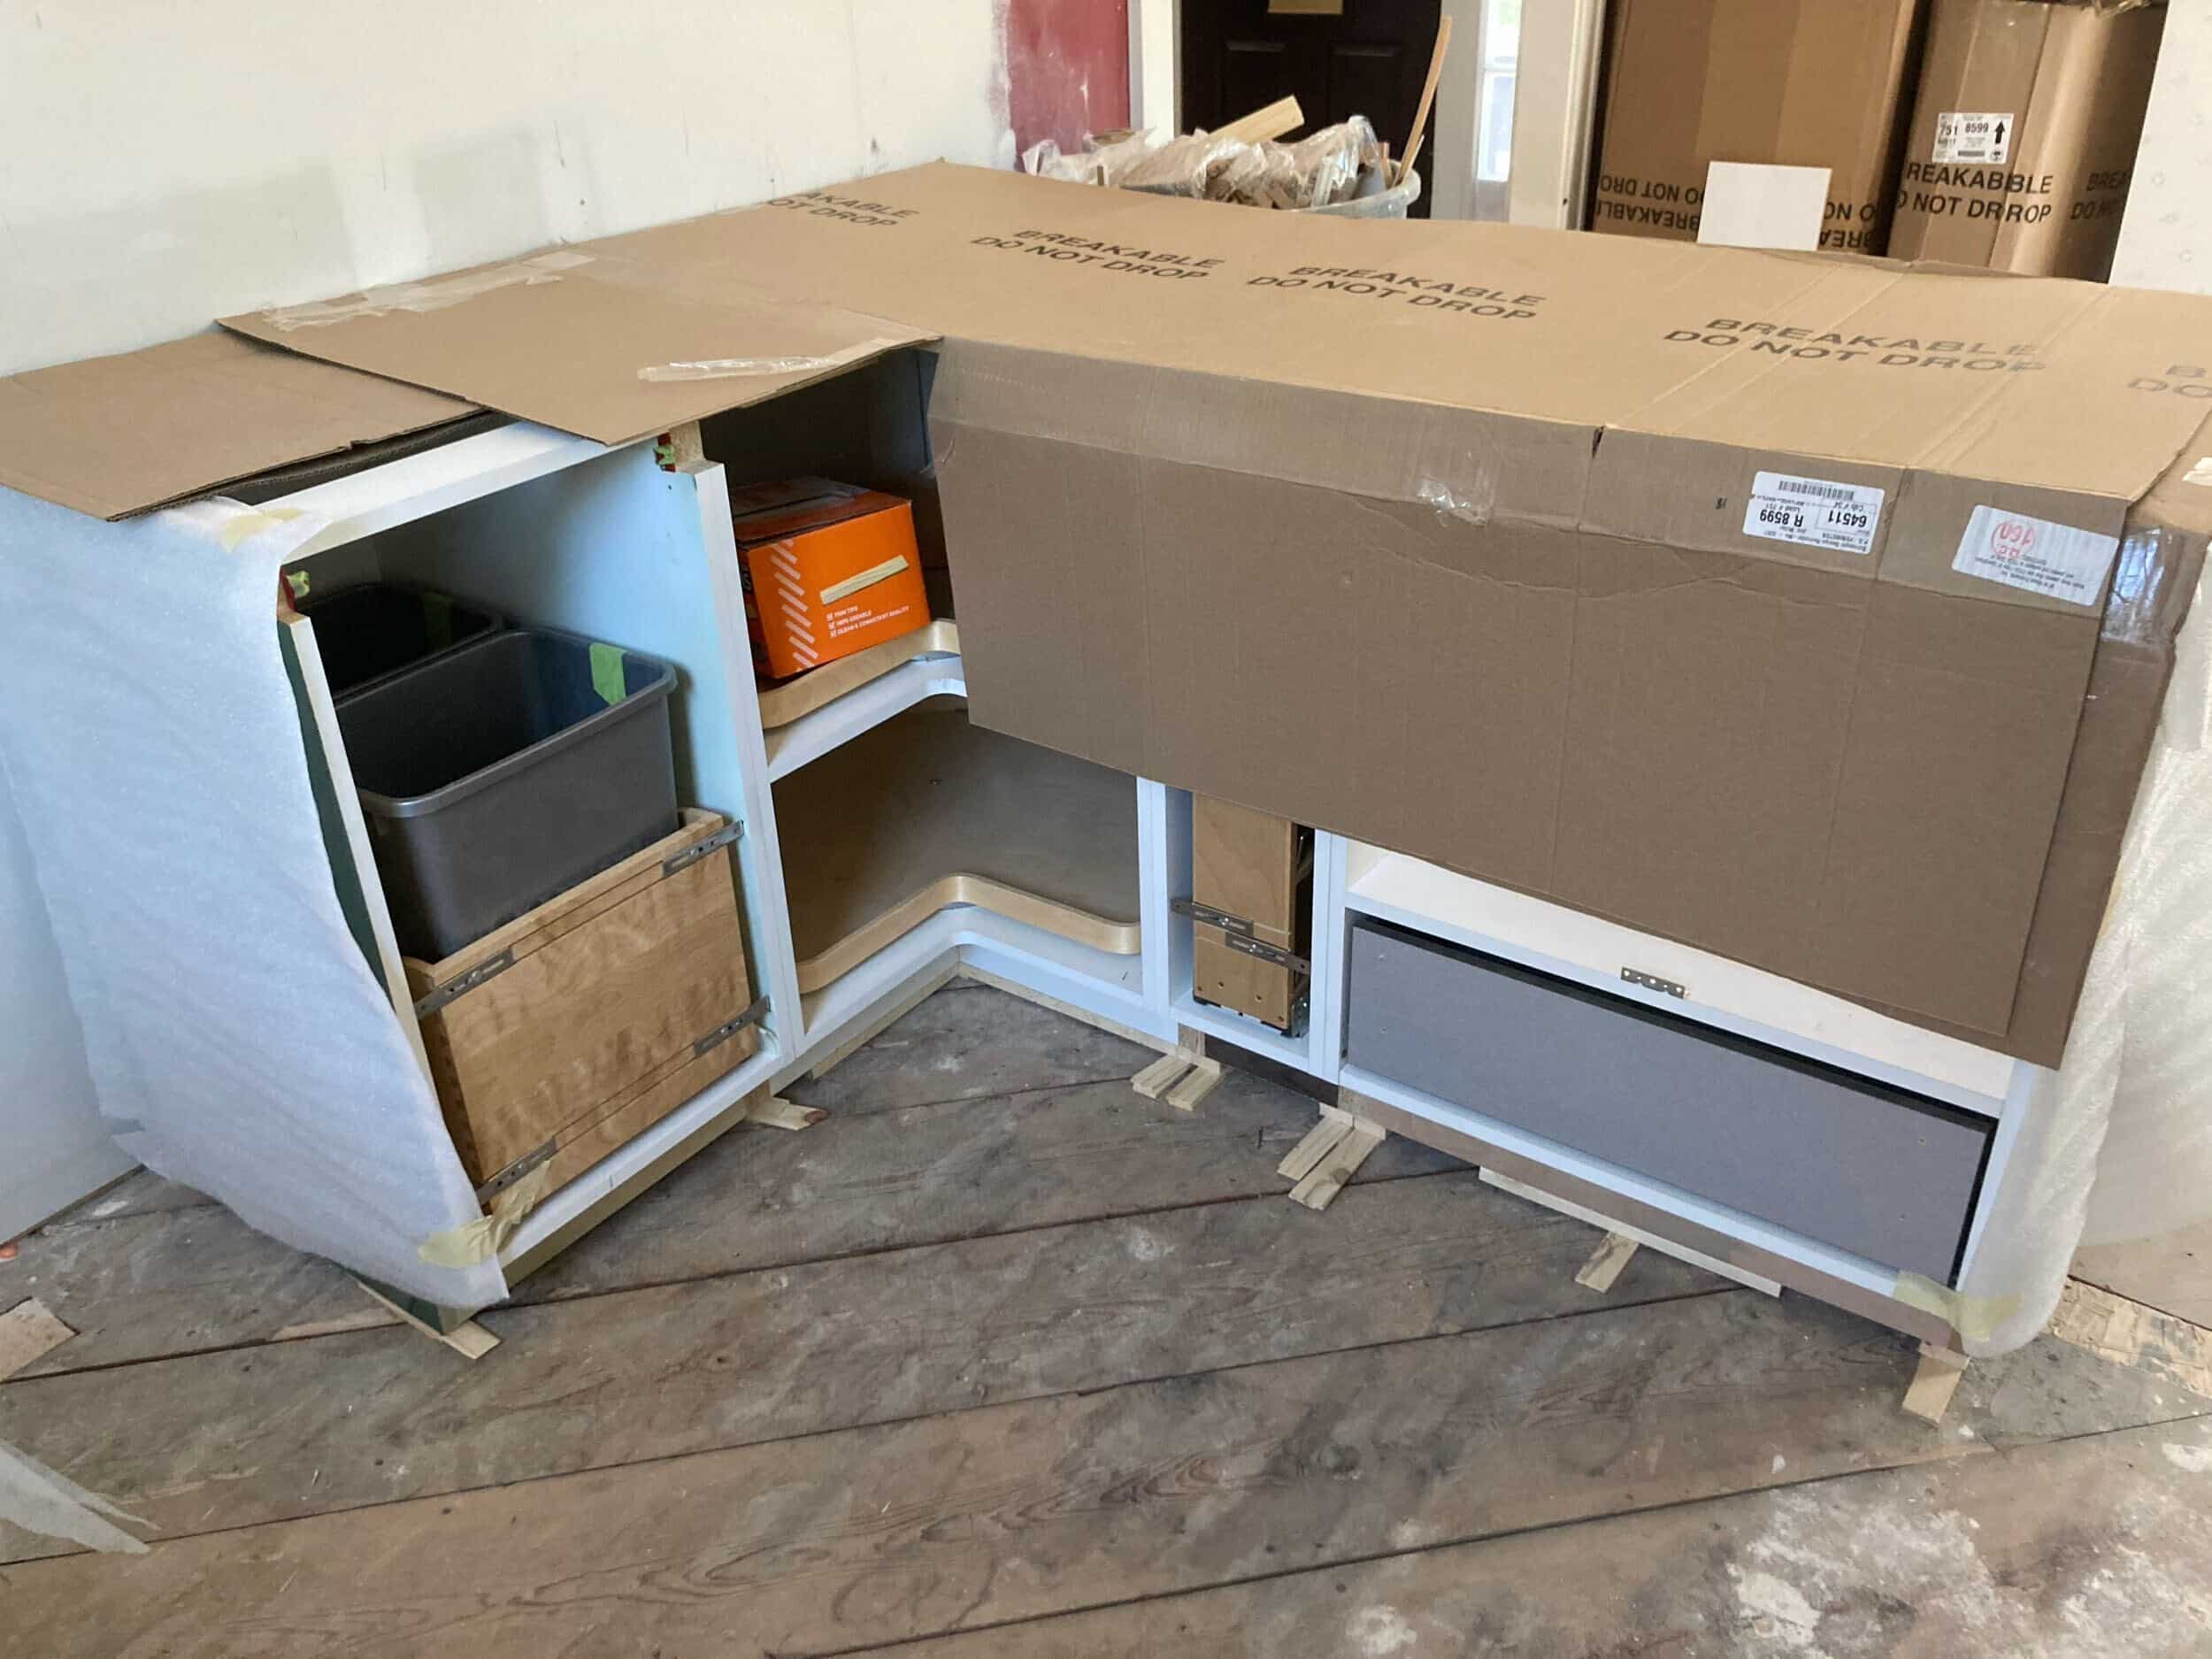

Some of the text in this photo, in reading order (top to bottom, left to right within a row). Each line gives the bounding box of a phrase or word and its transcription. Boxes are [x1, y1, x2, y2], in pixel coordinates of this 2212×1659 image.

[1965, 122, 1989, 133] 8599
[1600, 175, 1638, 196] DRO
[1642, 181, 1680, 202] NOT
[1913, 192, 1962, 216] NOT
[809, 206, 898, 227] DROP
[970, 236, 1209, 280] DO NOT DROP
[1013, 229, 1225, 269] BREAKABLE
[1246, 276, 1537, 319] DO NOT DROP
[1289, 266, 1547, 307] BREAKABLE
[1705, 319, 2043, 355] BREAKABLE
[1663, 329, 2047, 373] DO NOT DROP
[2126, 378, 2212, 399] DO
[1759, 509, 1804, 528] R 8599
[1828, 510, 1867, 528] 64511
